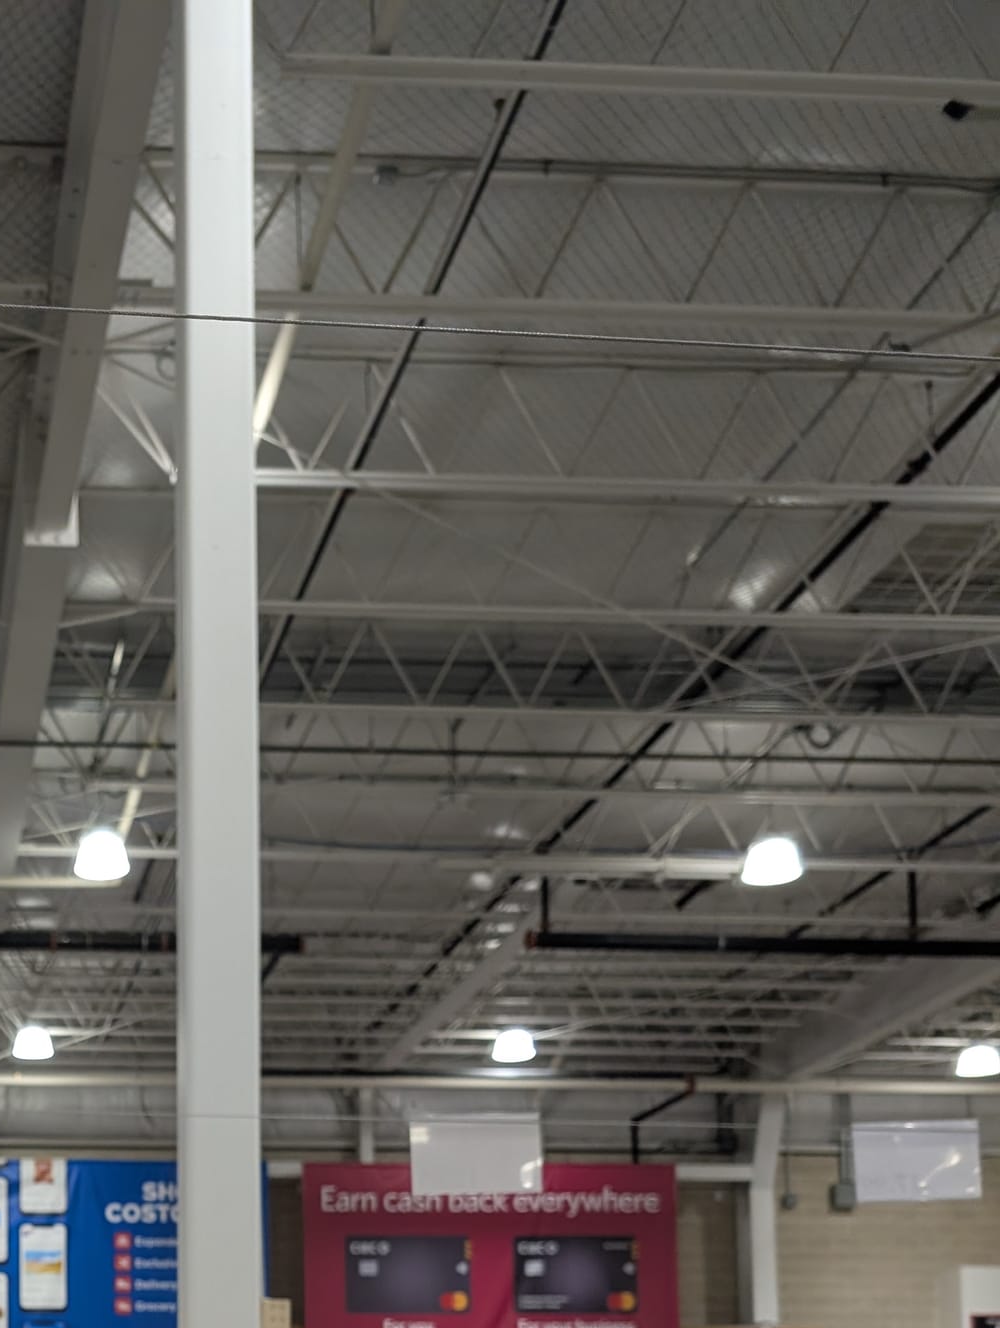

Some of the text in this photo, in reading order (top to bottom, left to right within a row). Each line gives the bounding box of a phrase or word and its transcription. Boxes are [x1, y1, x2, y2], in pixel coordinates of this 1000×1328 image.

[142, 1181, 178, 1201] SH
[320, 1185, 378, 1213] Earn
[513, 1185, 661, 1218] everywhere
